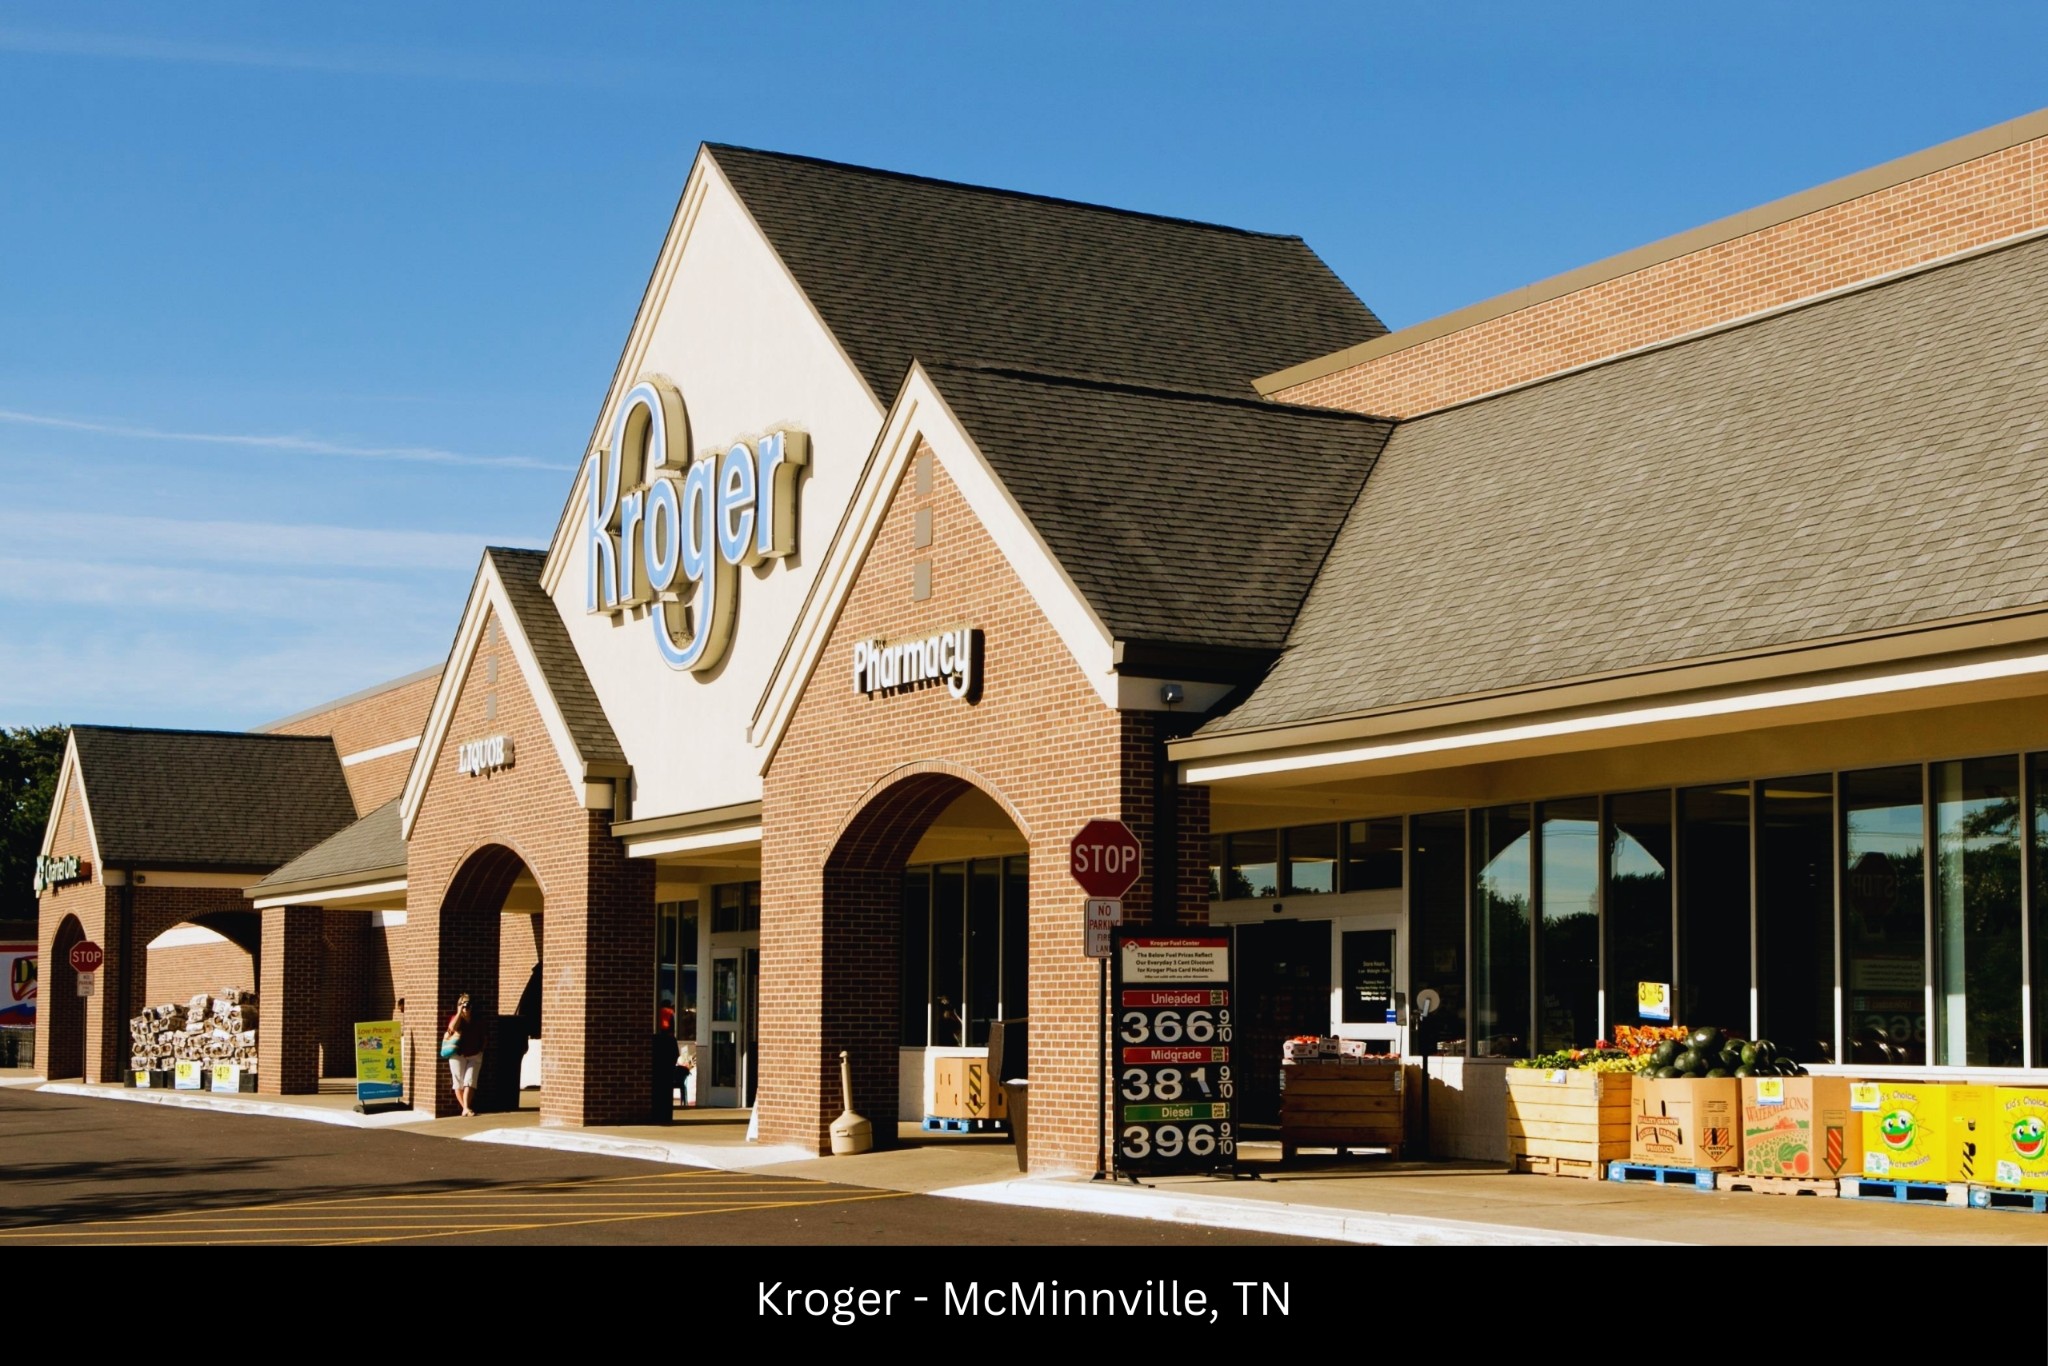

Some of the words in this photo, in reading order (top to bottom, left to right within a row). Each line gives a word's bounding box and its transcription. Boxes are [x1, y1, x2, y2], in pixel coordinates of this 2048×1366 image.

[587, 380, 797, 672] Kroger
[853, 629, 973, 698] Pharmacy
[458, 735, 505, 776] LIQUOR
[1074, 844, 1136, 873] STOP
[1098, 905, 1111, 916] NO
[73, 951, 101, 963] STOP
[1151, 993, 1200, 1004] Unleaded
[1640, 983, 1646, 1001] 3
[1121, 1010, 1215, 1043] 366
[1151, 1050, 1202, 1062] Midgrade
[1122, 1067, 1213, 1100] 381
[1162, 1107, 1193, 1117] Diesel
[1122, 1124, 1216, 1158] 396
